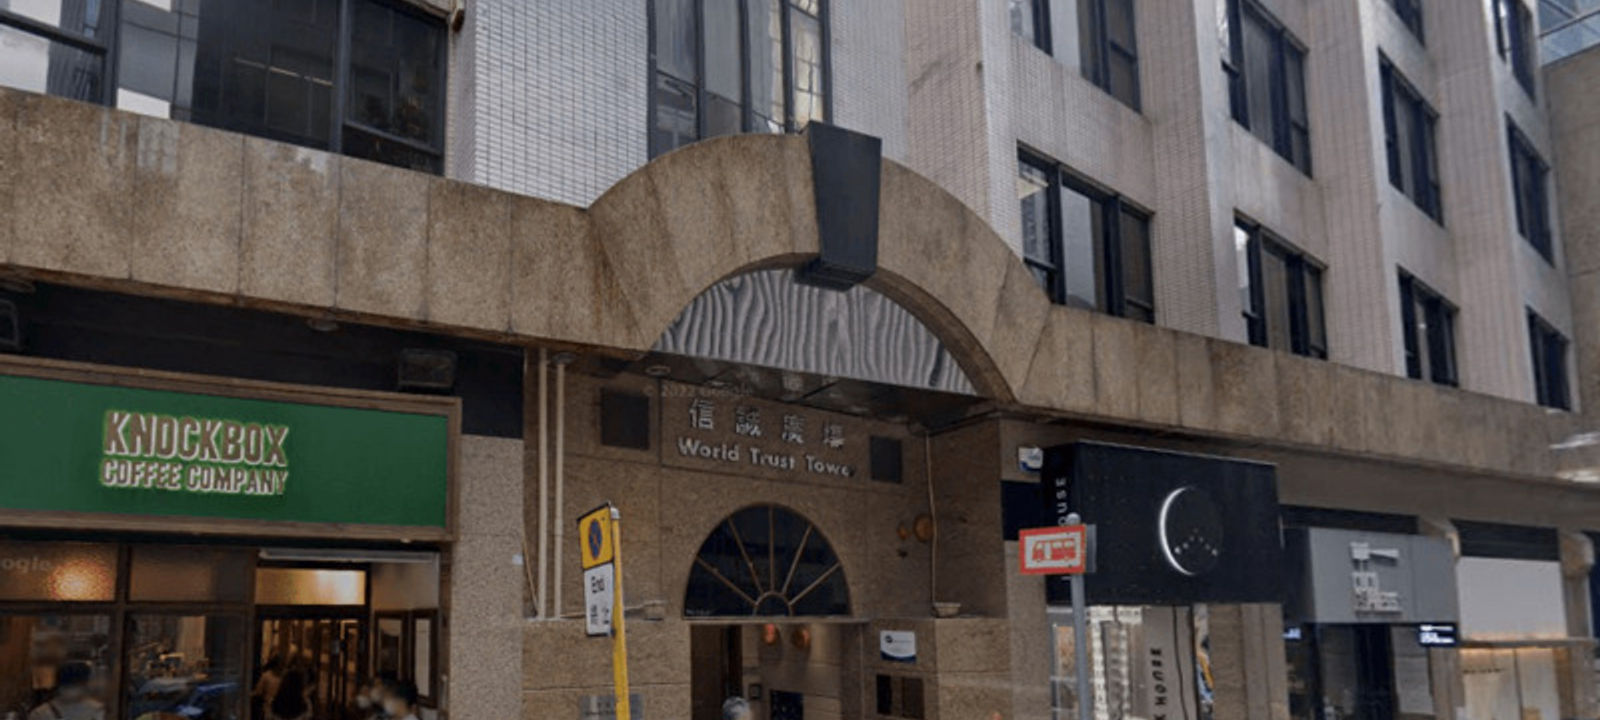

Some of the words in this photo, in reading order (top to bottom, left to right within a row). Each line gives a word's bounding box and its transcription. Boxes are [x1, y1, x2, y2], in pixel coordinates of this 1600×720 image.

[104, 411, 289, 466] KNOCKBOX
[678, 437, 740, 462] World
[749, 446, 796, 470] Trust
[102, 459, 182, 488] COFFEE
[187, 465, 288, 495] COMPANY
[1055, 477, 1068, 527] OUSE
